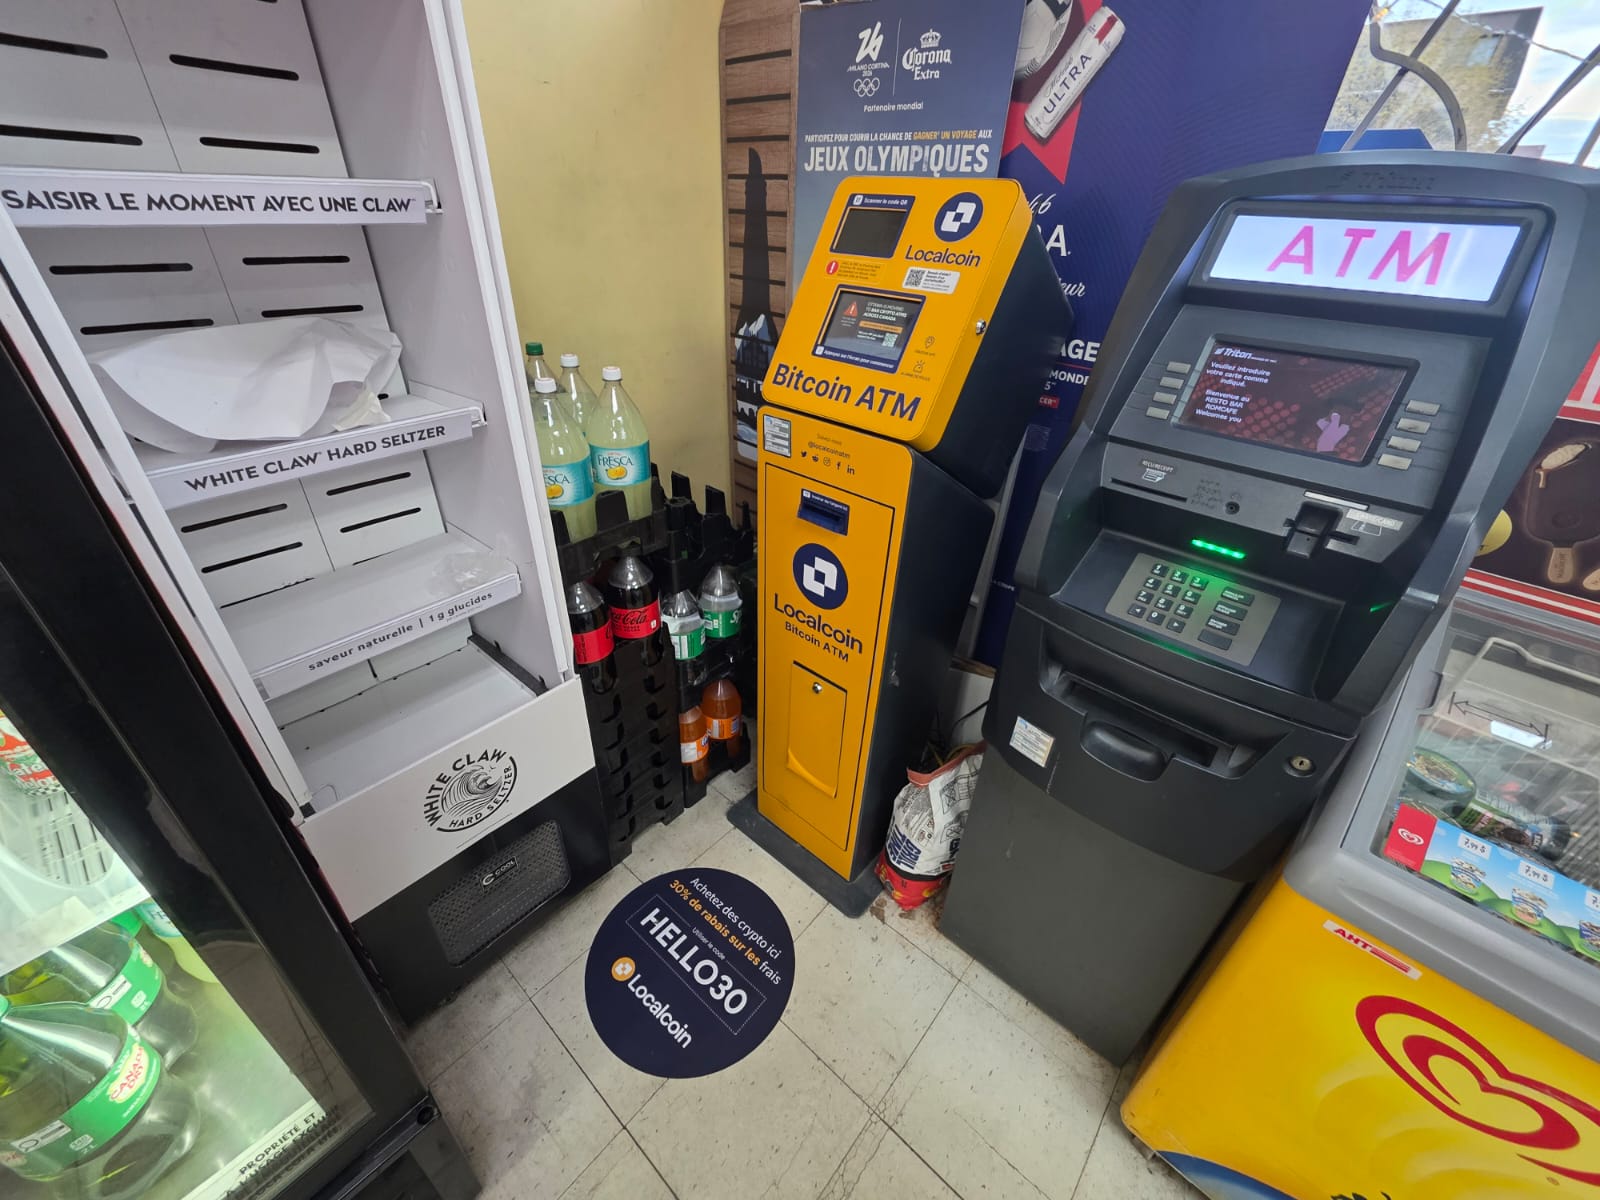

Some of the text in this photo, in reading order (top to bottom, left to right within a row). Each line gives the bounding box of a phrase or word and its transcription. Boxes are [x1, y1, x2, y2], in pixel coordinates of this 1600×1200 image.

[902, 47, 952, 72] Corona
[913, 66, 940, 80] Extra
[1043, 54, 1092, 114] ULTRA
[863, 101, 924, 112] Partenaire mondial
[804, 133, 834, 143] PARTICIPEZ
[834, 133, 849, 143] POUR
[870, 132, 878, 142] LA
[879, 132, 904, 141] CHANCE
[904, 131, 912, 141] DE
[941, 130, 950, 140] UN
[951, 130, 977, 139] VOYAGE
[978, 129, 992, 139] AUX
[804, 143, 990, 178] JEUX OLYMPIQUES
[1, 189, 101, 211] SAISIR
[108, 193, 139, 211] LE
[147, 194, 256, 212] MOMENT
[262, 196, 315, 213] AVEC
[319, 197, 359, 213] UNE
[905, 244, 981, 268] Localcoin
[1265, 225, 1452, 285] ATM
[1211, 361, 1271, 376] Veuillez introduire
[1223, 347, 1253, 359] Triton
[772, 363, 921, 421] Bitcoin ATM
[1205, 389, 1240, 400] Bienvenue
[1243, 375, 1269, 383] comme
[1205, 397, 1228, 405] RESTO
[184, 425, 446, 492] WHITE CLAW HARD SELTZER
[597, 454, 634, 468] FRESCA
[544, 474, 570, 485] ESCA
[308, 649, 354, 671] saveur
[357, 624, 413, 652] naturelle
[437, 612, 445, 621] g
[448, 592, 493, 616] glucides
[774, 592, 863, 654] Localcoin
[785, 621, 849, 663] Bitcoin ATM
[424, 749, 507, 826] WHITE CLAW
[449, 766, 512, 827] HARD SELTZER
[670, 879, 782, 985] 30% de rabais sur les frais
[690, 877, 782, 959] Achetez des crypto ici
[1334, 927, 1372, 950] AHT
[640, 907, 748, 1014] HELLO30
[627, 974, 692, 1048] Localcoin
[240, 1112, 316, 1175] PROPRIÉTÉ ET
